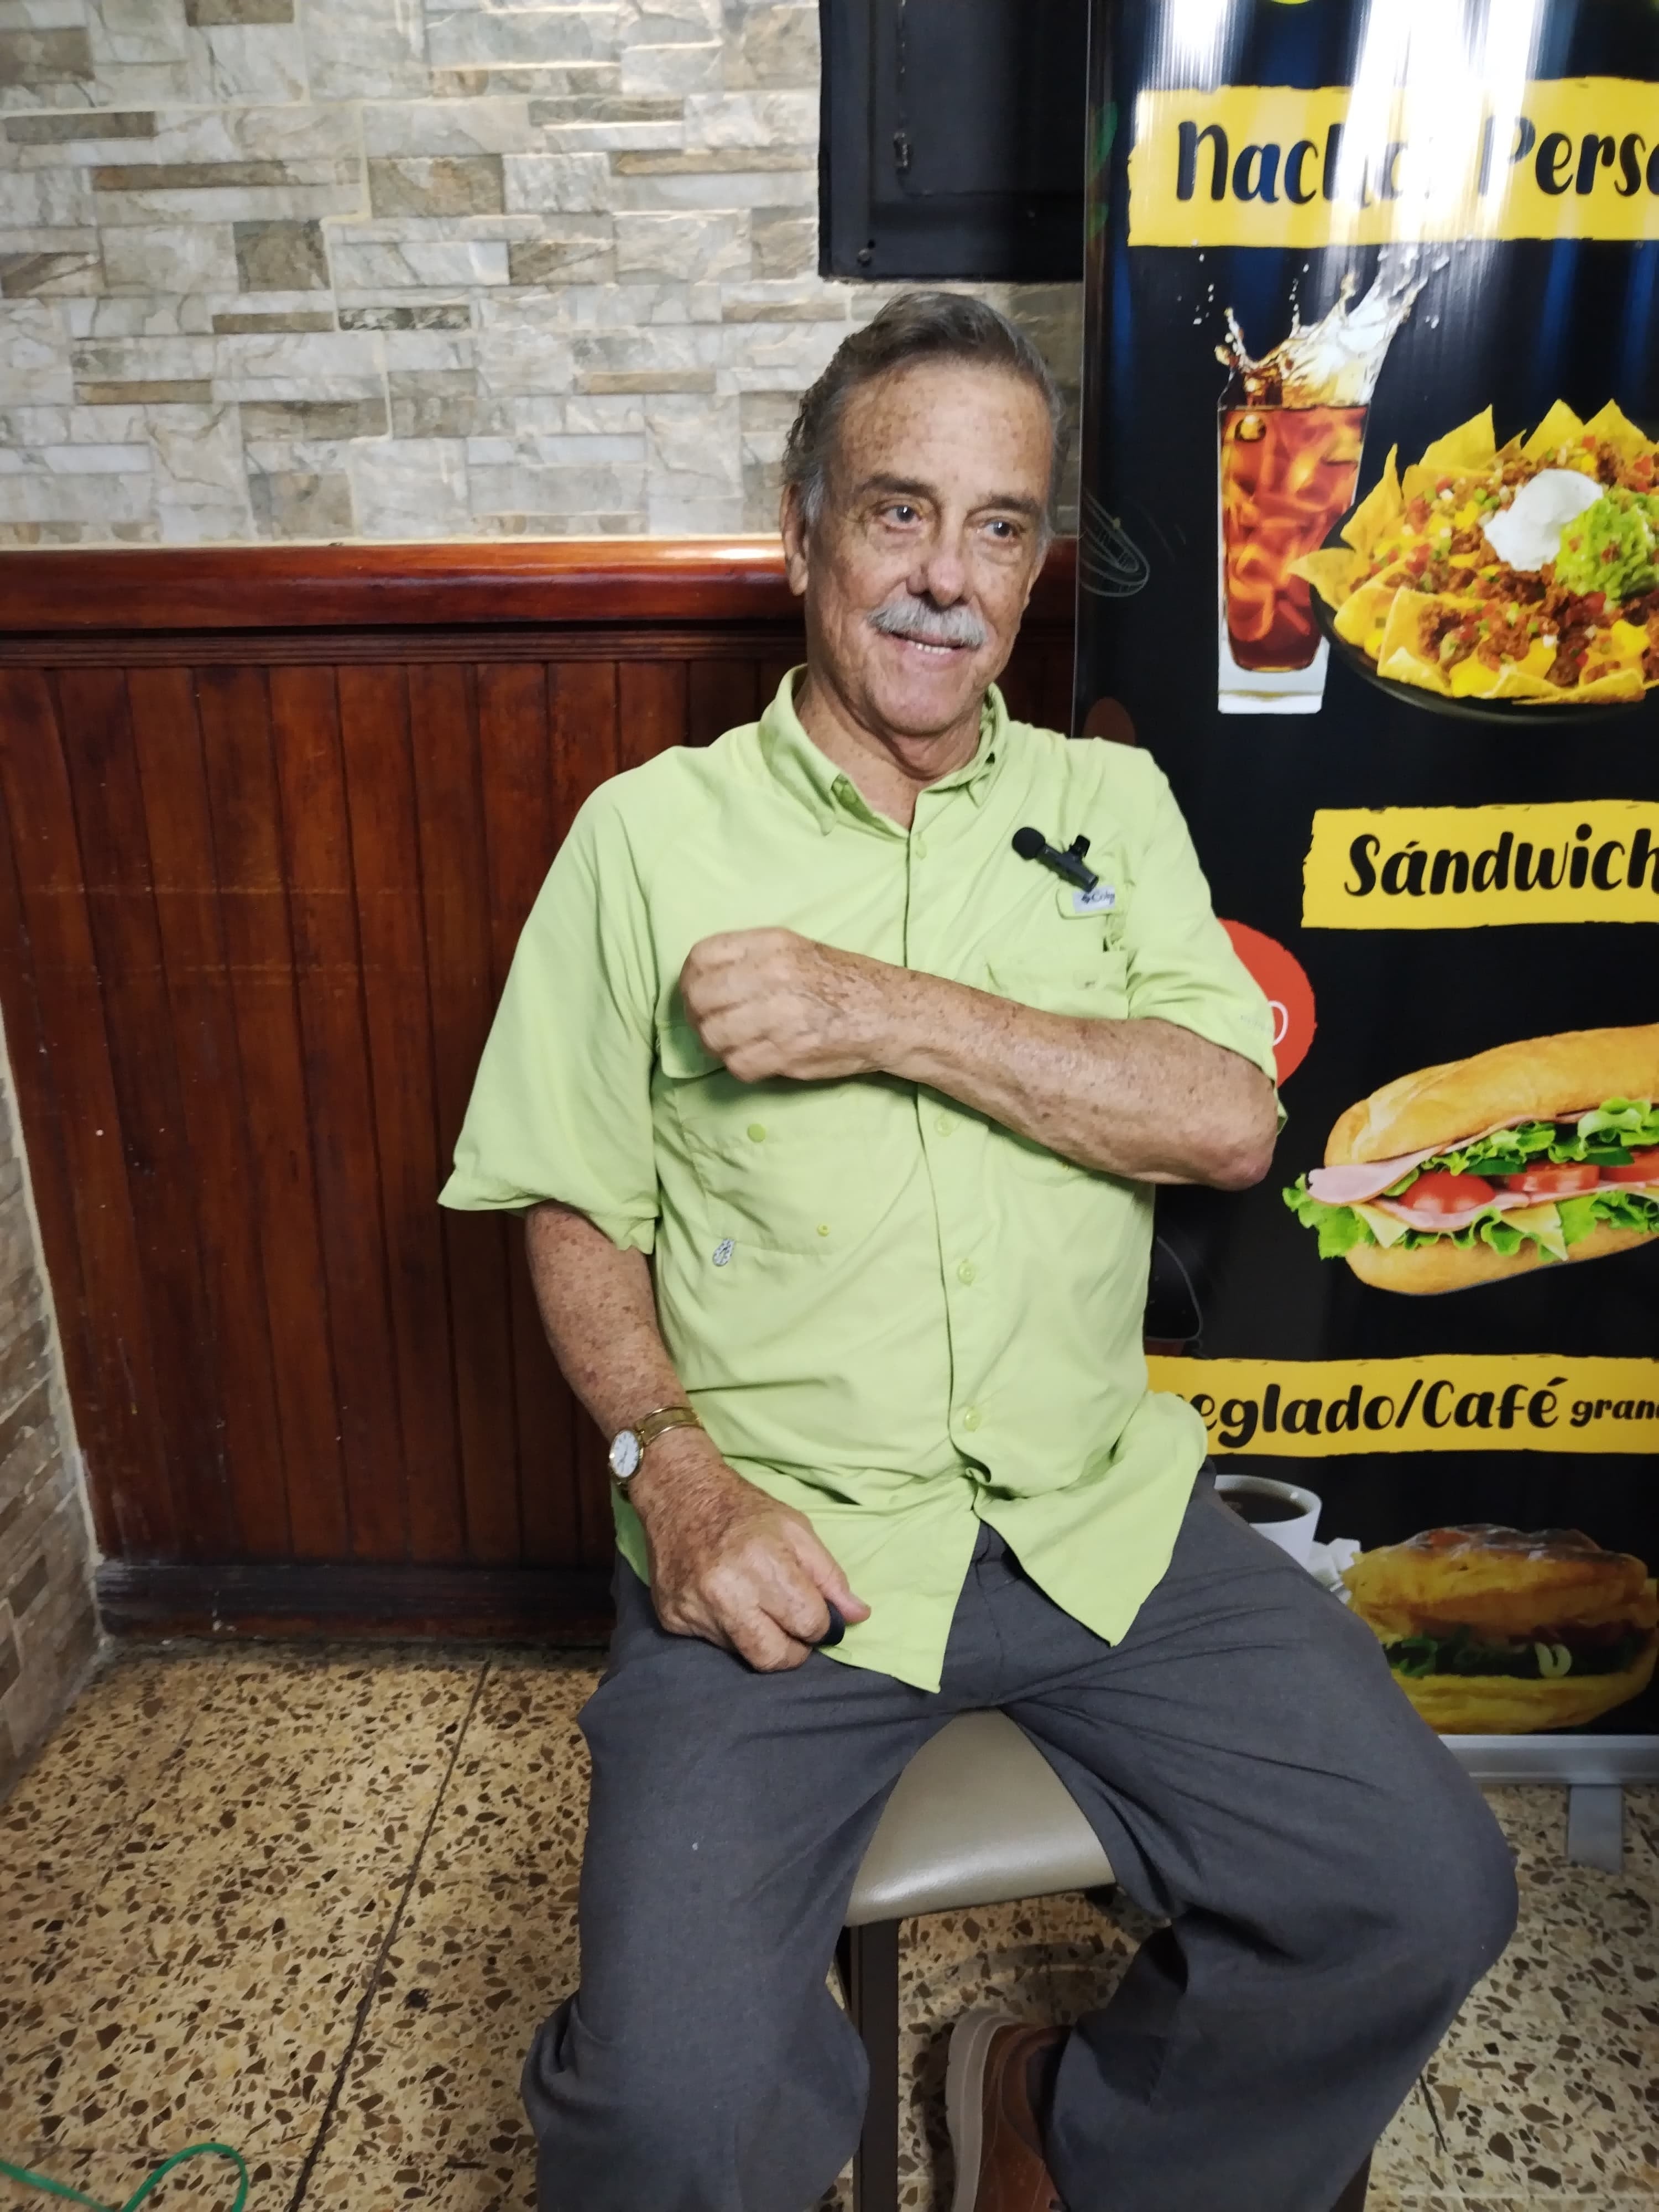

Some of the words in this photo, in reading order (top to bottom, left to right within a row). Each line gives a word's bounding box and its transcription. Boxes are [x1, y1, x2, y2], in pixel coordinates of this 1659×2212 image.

[1344, 823, 1659, 896] Sándwich
[1177, 1376, 1568, 1448] eglado/Café
[1570, 1400, 1659, 1427] gran
